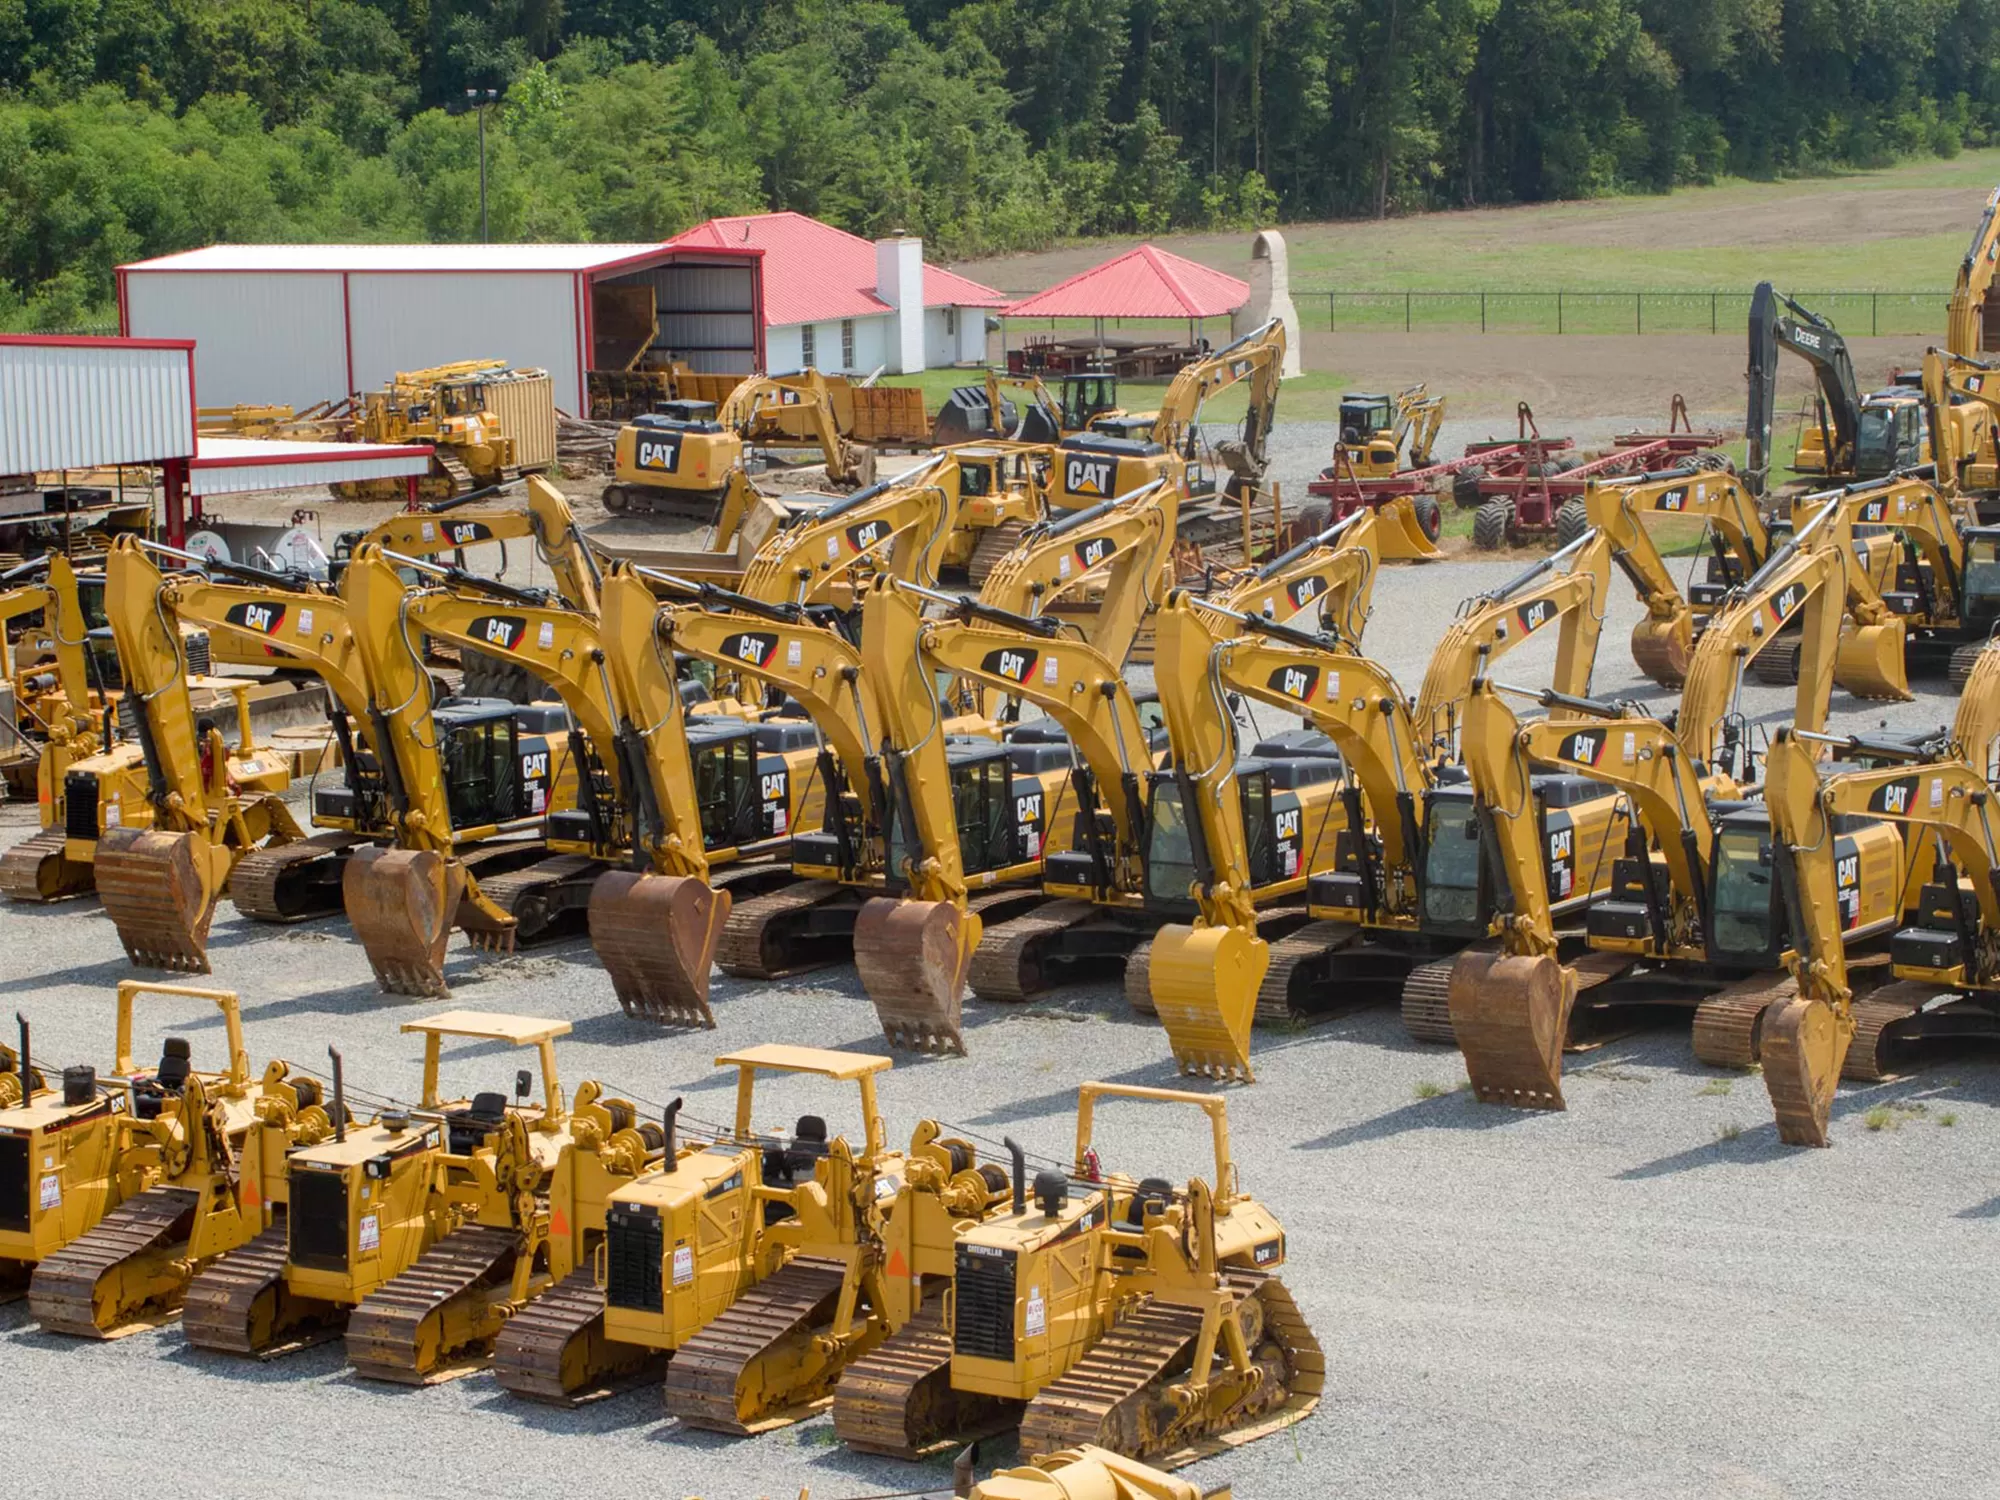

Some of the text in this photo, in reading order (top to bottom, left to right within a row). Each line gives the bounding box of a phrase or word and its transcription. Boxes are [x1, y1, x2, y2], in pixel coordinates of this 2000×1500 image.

[1795, 327, 1821, 348] DEERE
[640, 442, 675, 468] CAT
[1348, 450, 1358, 463] AT
[1067, 460, 1111, 494] CAT
[1665, 492, 1682, 510] CAT
[1867, 503, 1882, 521] CAT
[454, 523, 476, 545] CAT
[858, 522, 877, 548] CAT
[1086, 539, 1103, 566] CAT
[1297, 577, 1315, 606] CAT
[1779, 586, 1796, 618] CAT
[245, 605, 272, 633] CAT
[1527, 601, 1545, 629] CAT
[486, 618, 513, 647] CAT
[739, 635, 765, 664] CAT
[999, 651, 1025, 680] CAT
[1284, 668, 1307, 698] CAT
[1573, 734, 1596, 764] CAT
[523, 753, 547, 779] CAT
[762, 773, 786, 800] CAT
[1884, 785, 1908, 813] CAT
[1017, 794, 1041, 822] CAT
[1275, 810, 1299, 840] CAT
[1551, 830, 1571, 860] CAT
[1837, 856, 1857, 888] CAT
[426, 1130, 440, 1149] CAT
[629, 1203, 641, 1213] CAT
[1080, 1213, 1093, 1233] CAT
[967, 1244, 1003, 1258] CATERPILLAR
